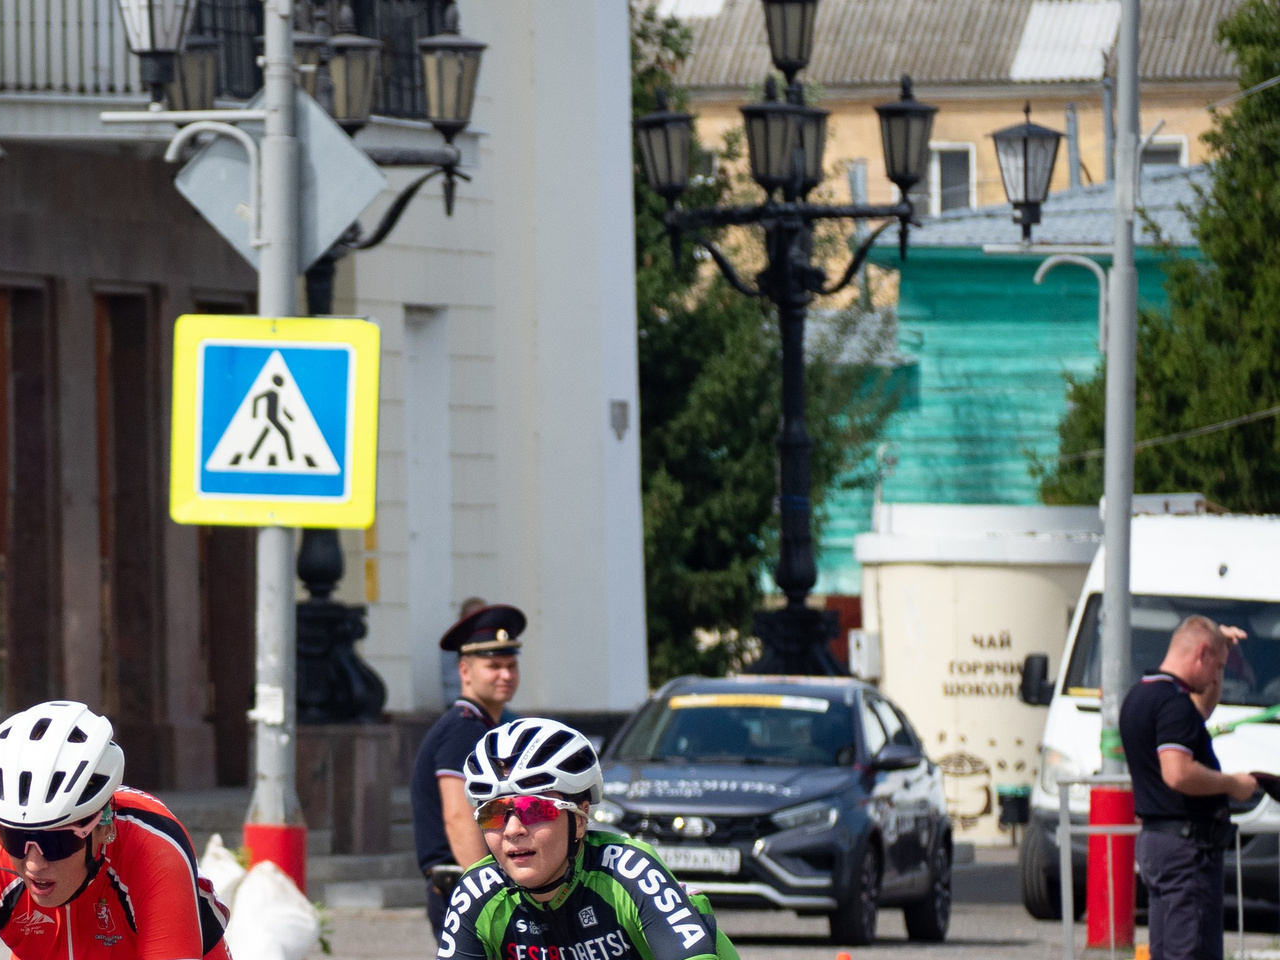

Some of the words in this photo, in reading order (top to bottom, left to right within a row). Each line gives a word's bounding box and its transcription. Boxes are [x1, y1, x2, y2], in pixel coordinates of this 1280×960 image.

[972, 630, 1011, 649] ЧАЙ
[948, 660, 1024, 676] ГОРЯЧИ
[942, 682, 1015, 697] ШОКОЛ
[601, 844, 706, 950] RUSSIA
